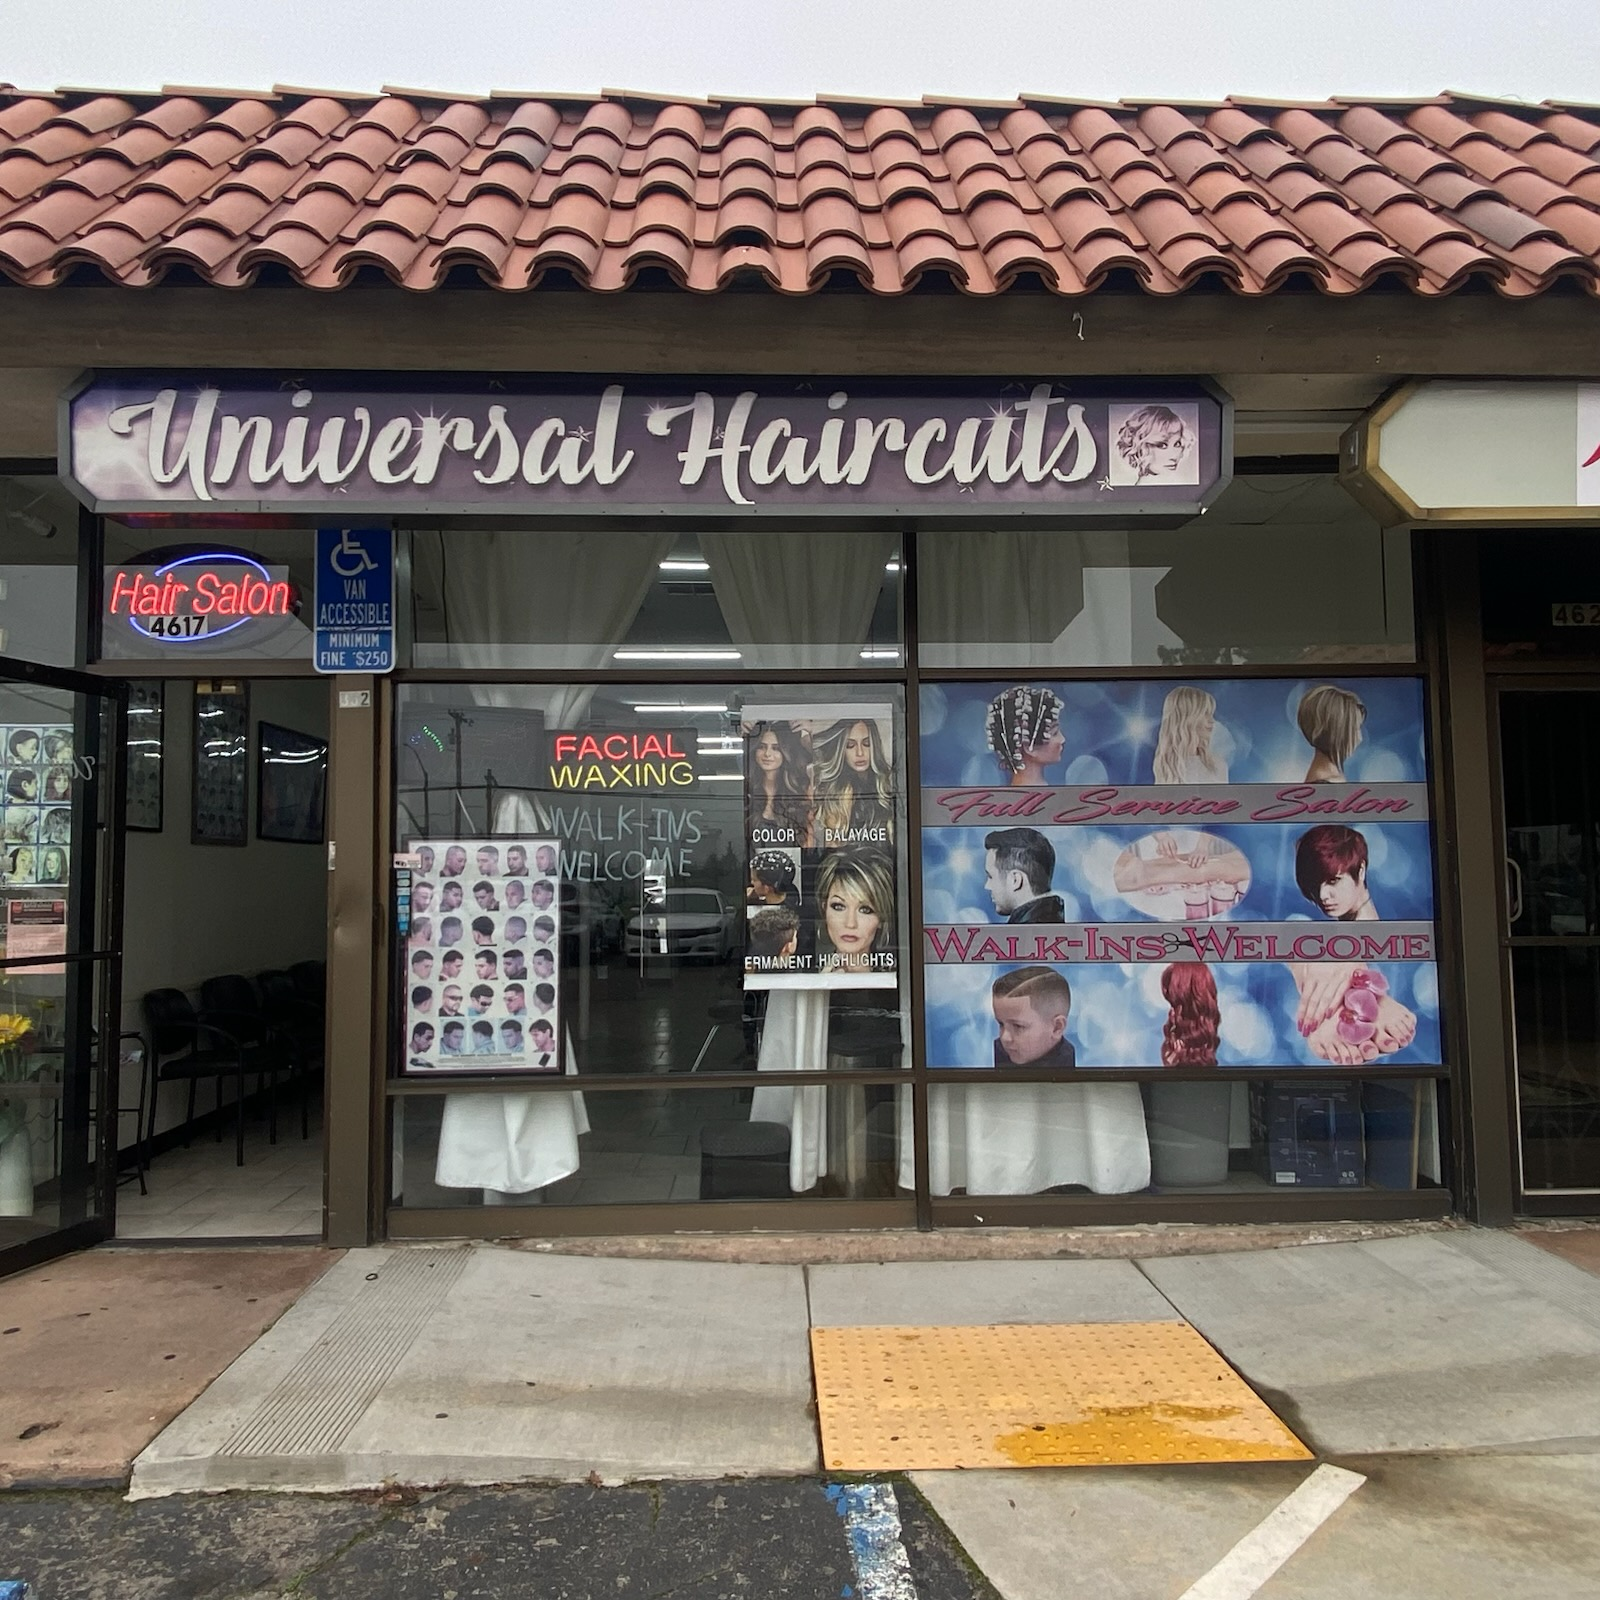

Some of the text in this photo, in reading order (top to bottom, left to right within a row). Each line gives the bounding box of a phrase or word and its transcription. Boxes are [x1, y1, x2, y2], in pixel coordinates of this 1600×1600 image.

[108, 384, 1098, 504] Universal Haircuts
[110, 572, 289, 615] Hair Salon
[343, 579, 367, 600] VAN
[320, 603, 390, 625] ACCESSIBLE
[151, 616, 205, 637] 4617
[329, 633, 380, 648] MINIMUM
[320, 650, 388, 667] FINE $250
[556, 734, 686, 761] FACIAL
[551, 762, 694, 789] WAXING
[936, 786, 1413, 823] Full Service Salon
[550, 805, 703, 843] WALK-INS
[752, 828, 887, 843] COLOR BALAYAGE
[924, 926, 1431, 963] WALK-INS WELCOME
[819, 952, 894, 968] HIGHLIGHTS
